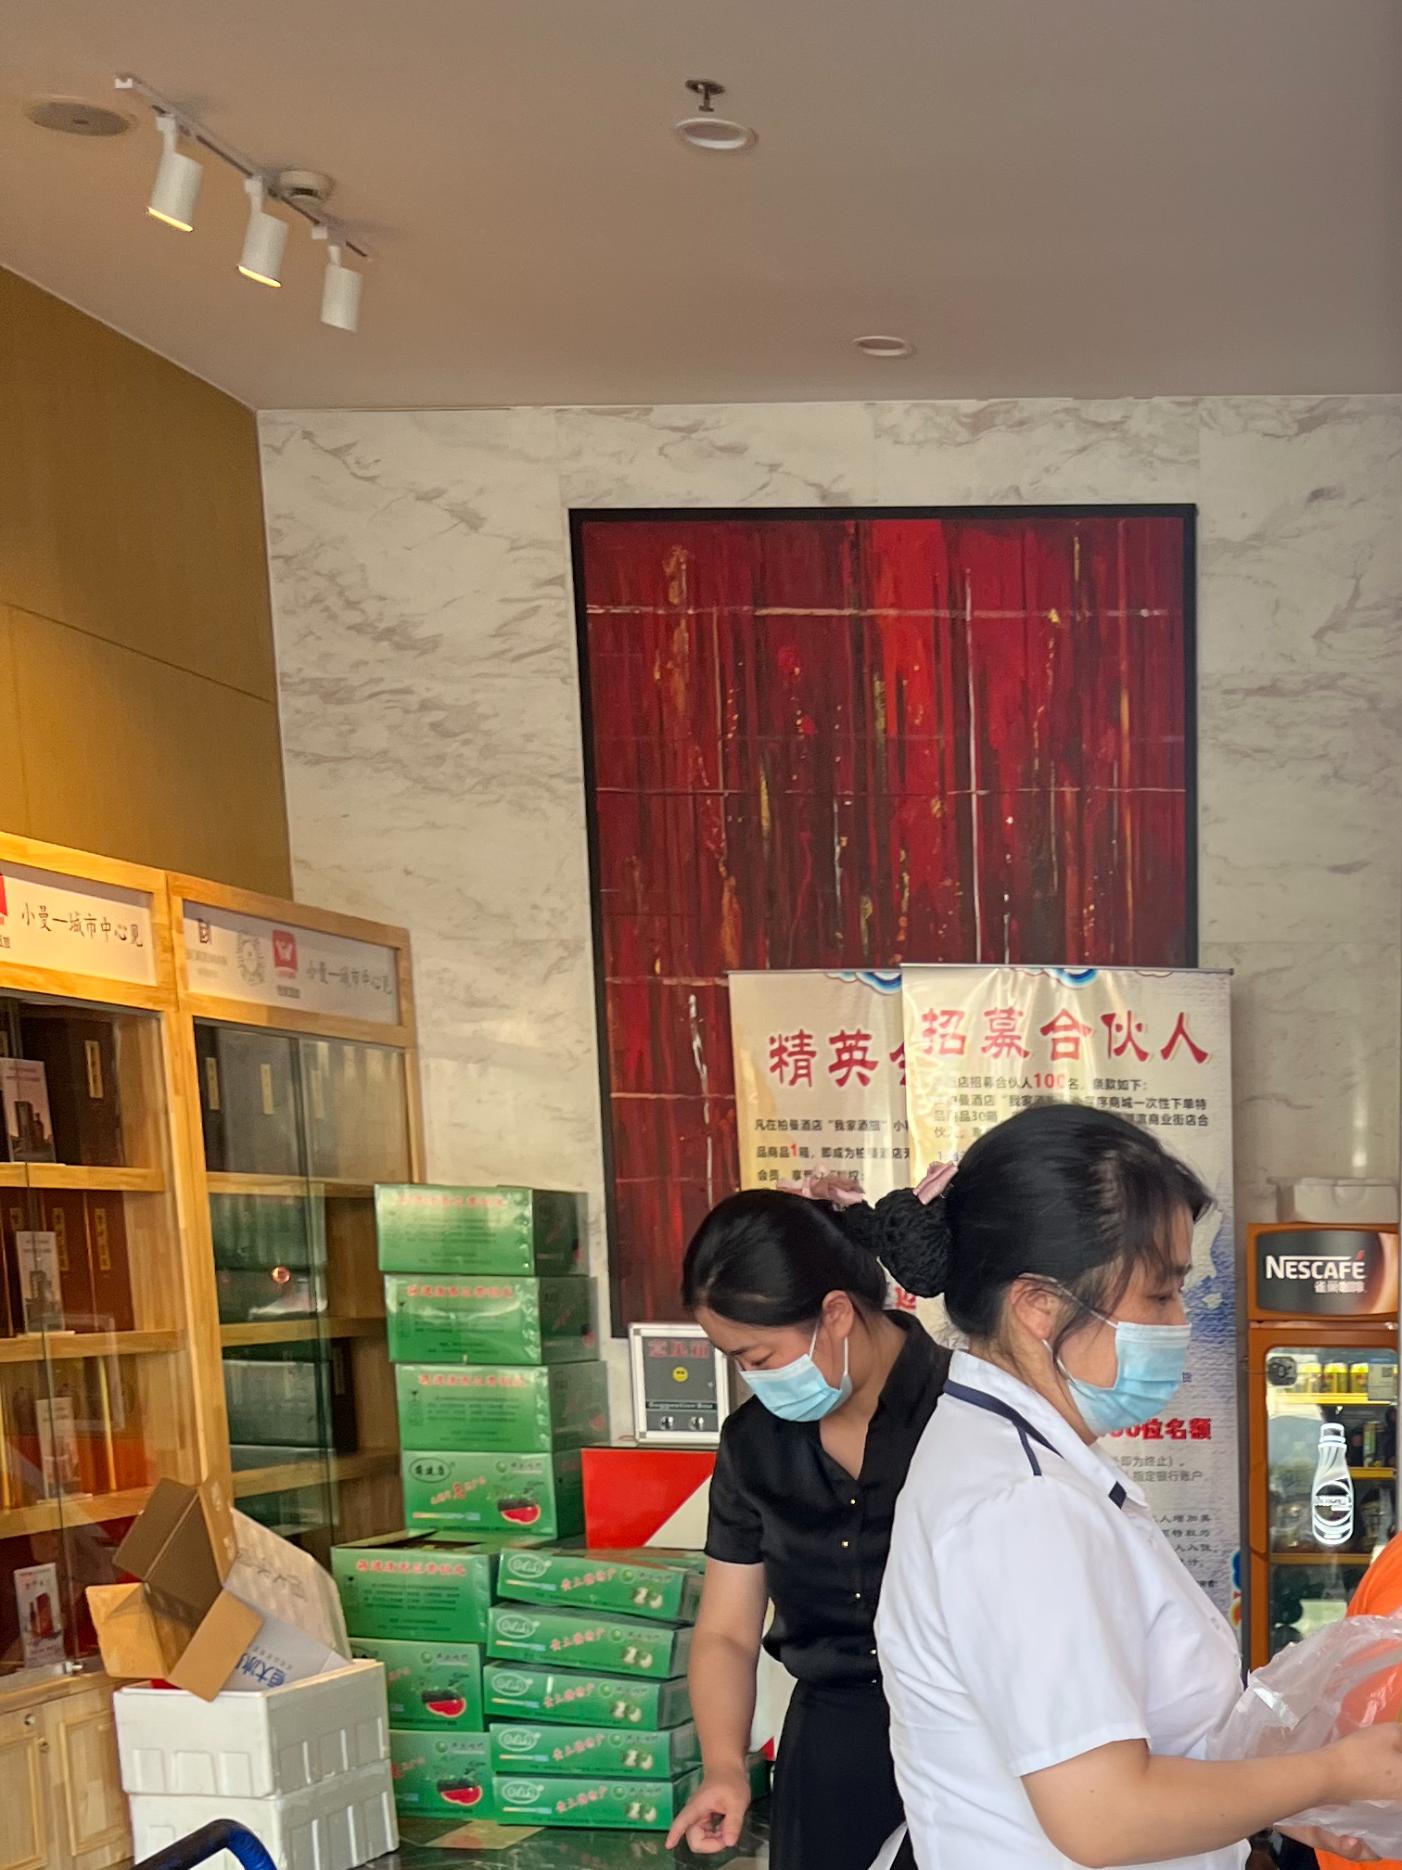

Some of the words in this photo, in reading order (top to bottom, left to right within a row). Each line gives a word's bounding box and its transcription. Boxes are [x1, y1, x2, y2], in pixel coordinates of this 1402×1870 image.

[921, 1008, 1208, 1063] 招募合伙人
